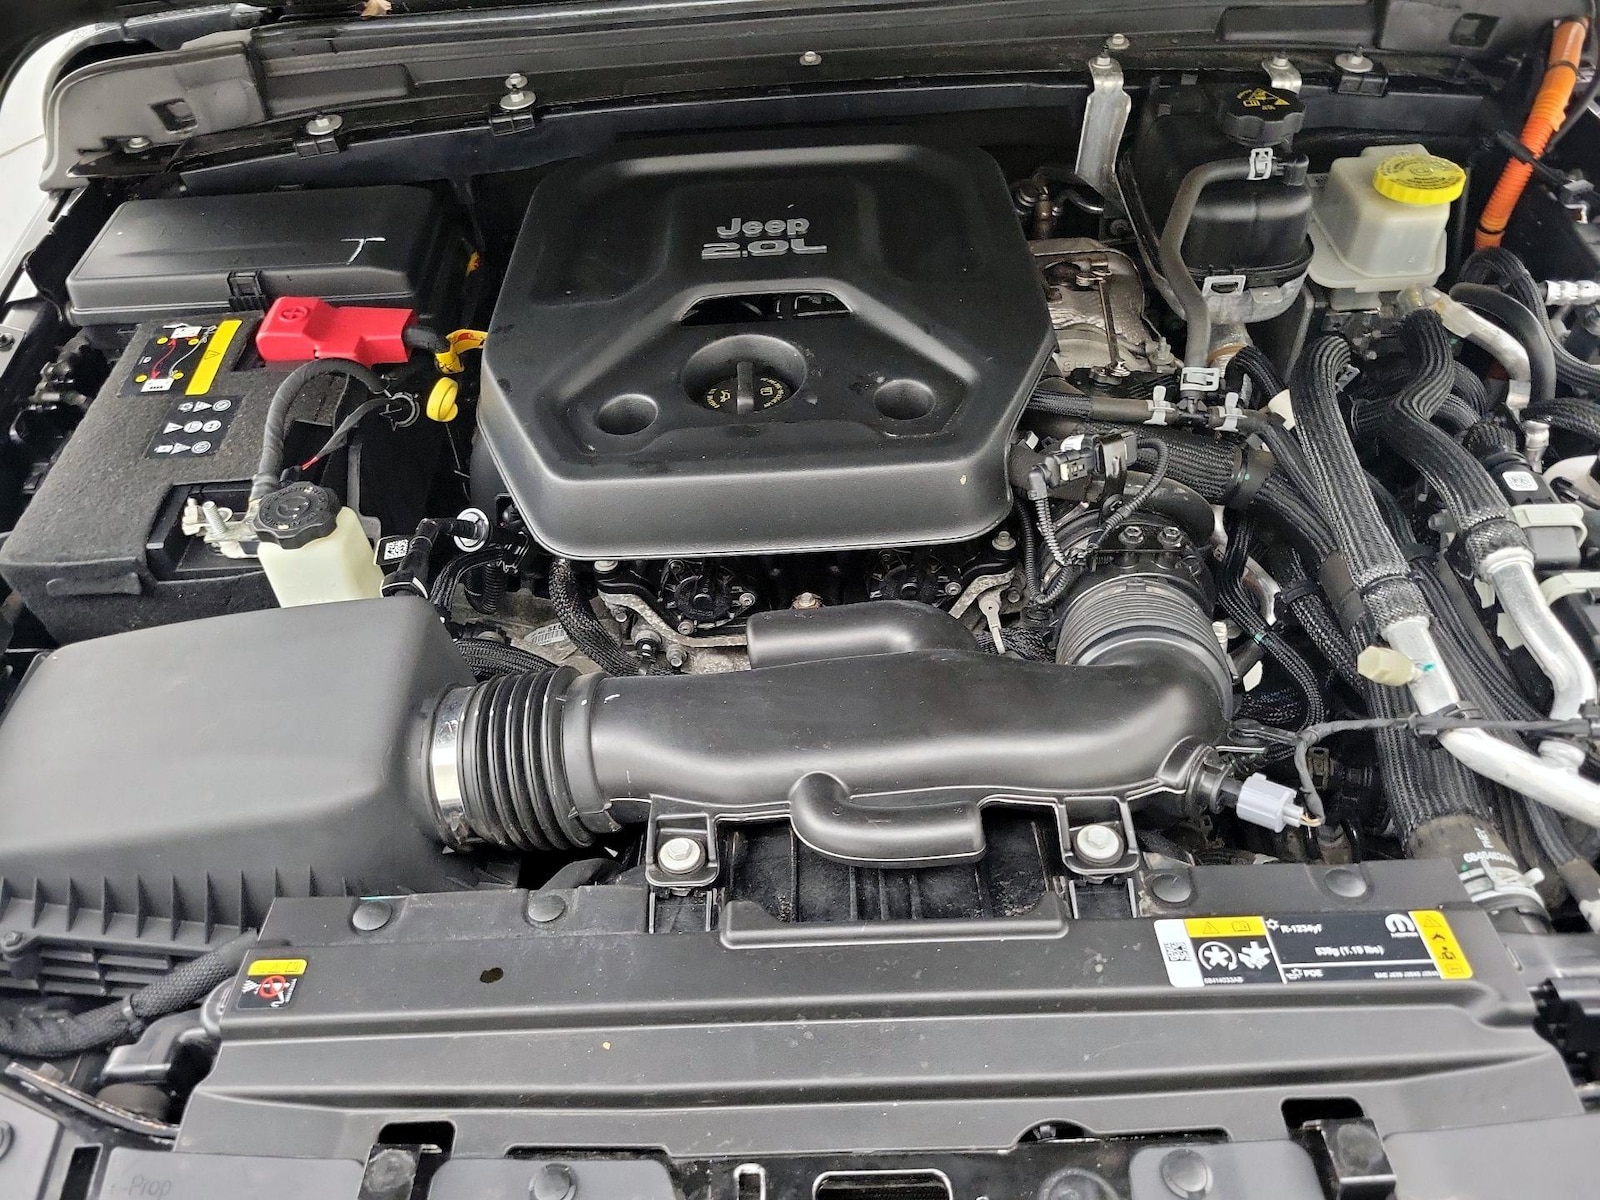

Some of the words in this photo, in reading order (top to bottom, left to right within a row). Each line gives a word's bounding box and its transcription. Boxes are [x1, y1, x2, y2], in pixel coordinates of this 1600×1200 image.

[716, 217, 810, 238] Jeep
[701, 238, 828, 259] 2.0L
[1280, 923, 1322, 934] R-1234yf
